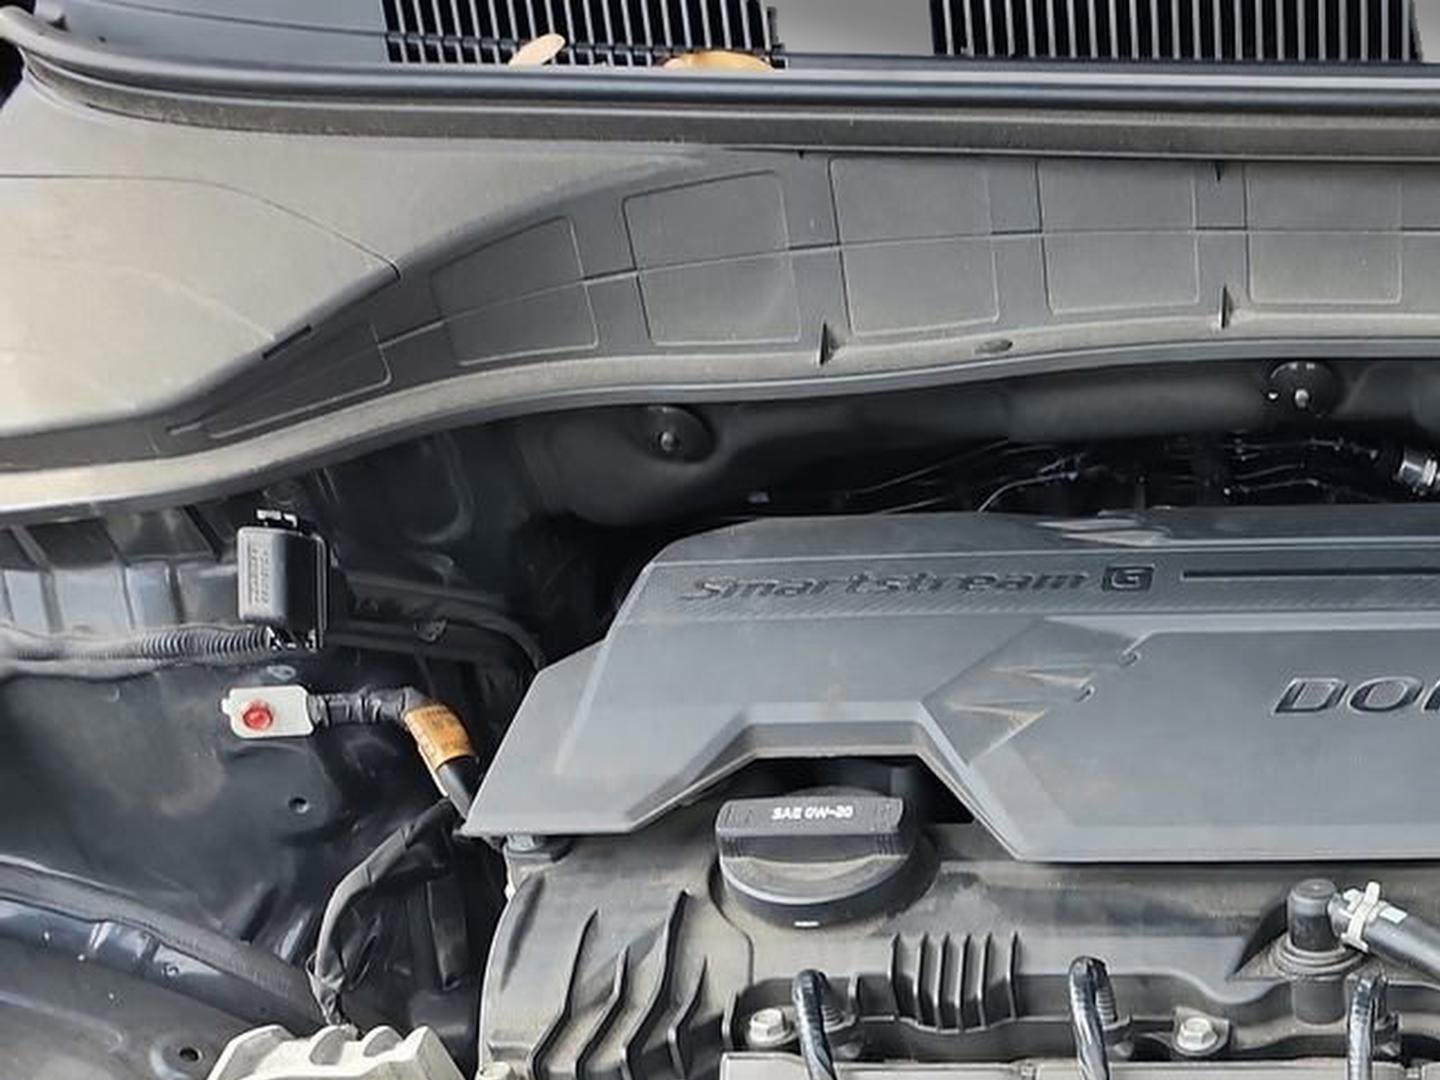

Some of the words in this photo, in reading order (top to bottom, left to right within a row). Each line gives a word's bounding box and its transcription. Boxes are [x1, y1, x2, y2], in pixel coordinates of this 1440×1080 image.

[683, 570, 1088, 600] Smartstream
[1105, 565, 1152, 591] G
[771, 806, 803, 820] SAE
